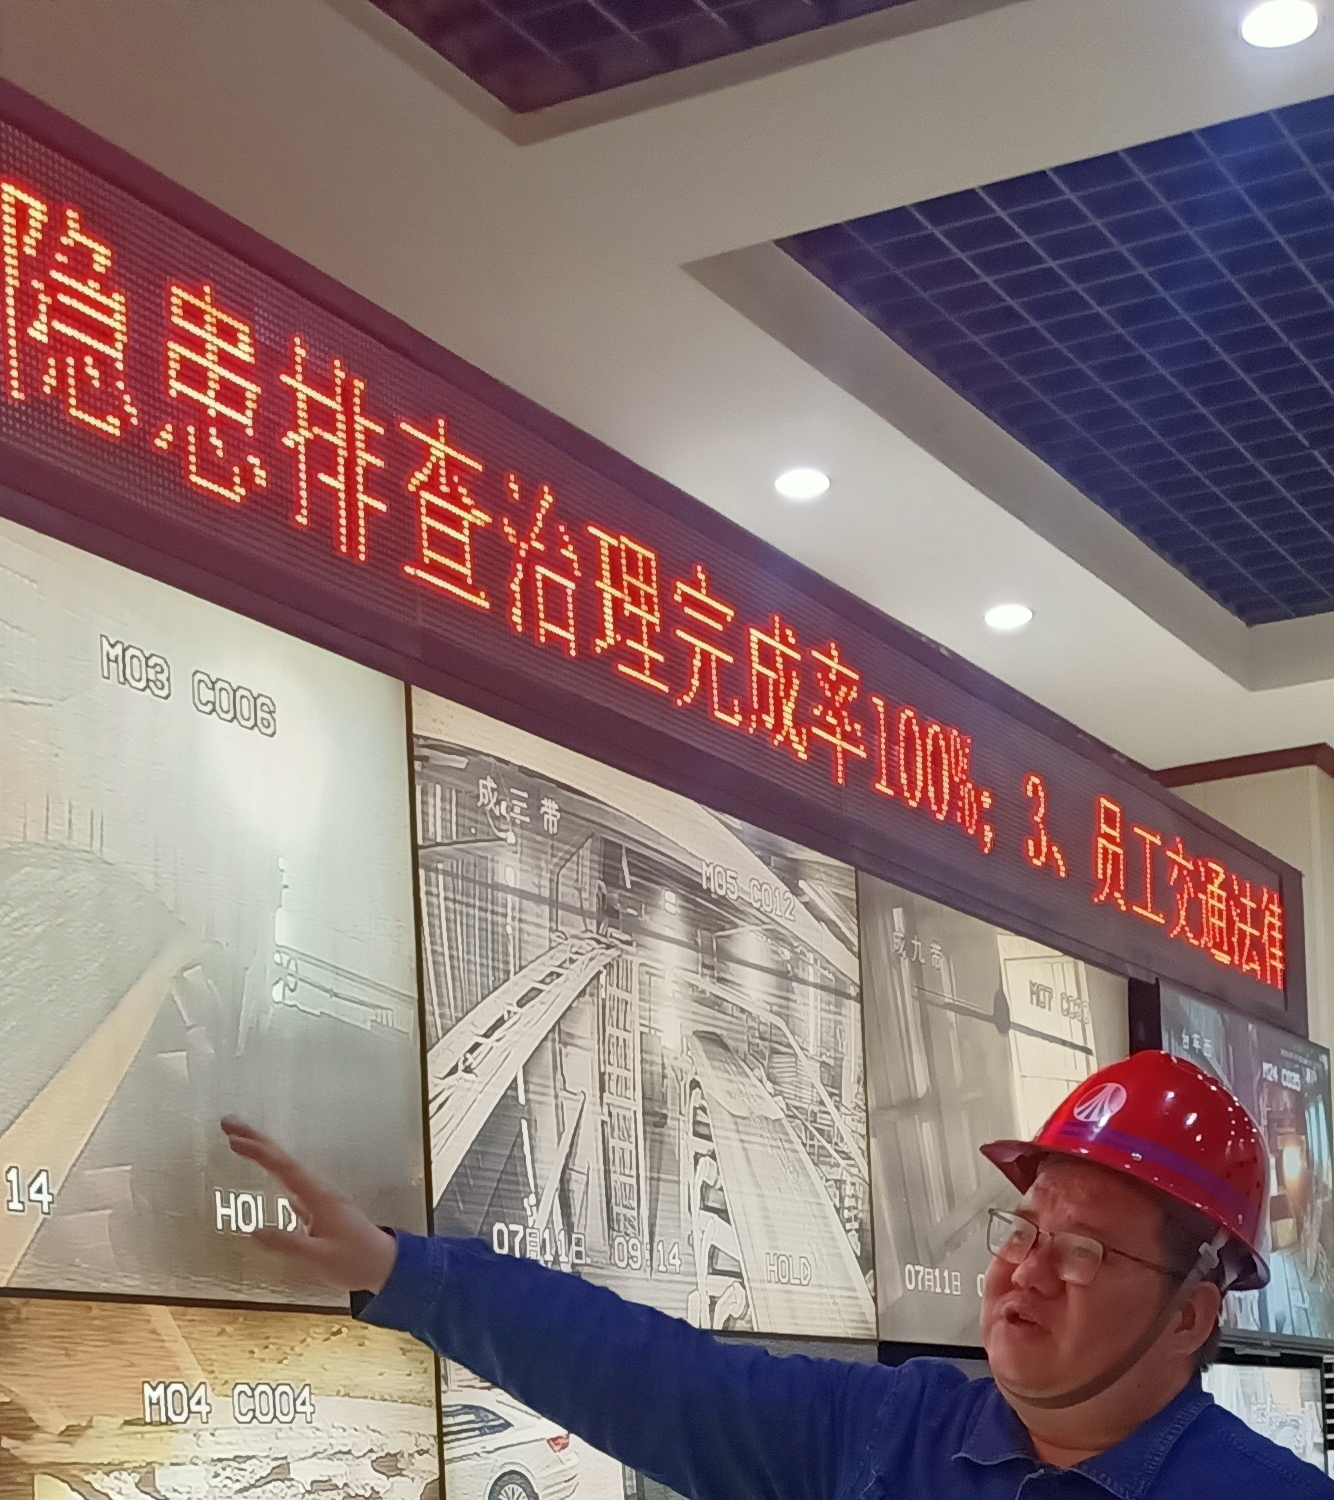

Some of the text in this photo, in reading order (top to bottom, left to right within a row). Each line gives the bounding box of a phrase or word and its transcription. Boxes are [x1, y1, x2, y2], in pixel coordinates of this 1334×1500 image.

[99, 634, 277, 738] M03 C006
[477, 775, 561, 836] 成三带
[701, 861, 797, 922] M05 C012
[1029, 980, 1053, 1012] M07
[5, 1165, 54, 1215] 14
[492, 1221, 587, 1264] 07月11日
[765, 1253, 811, 1286] HOLD
[904, 1263, 961, 1296] 07月11日
[142, 1380, 315, 1424] M04 C004
